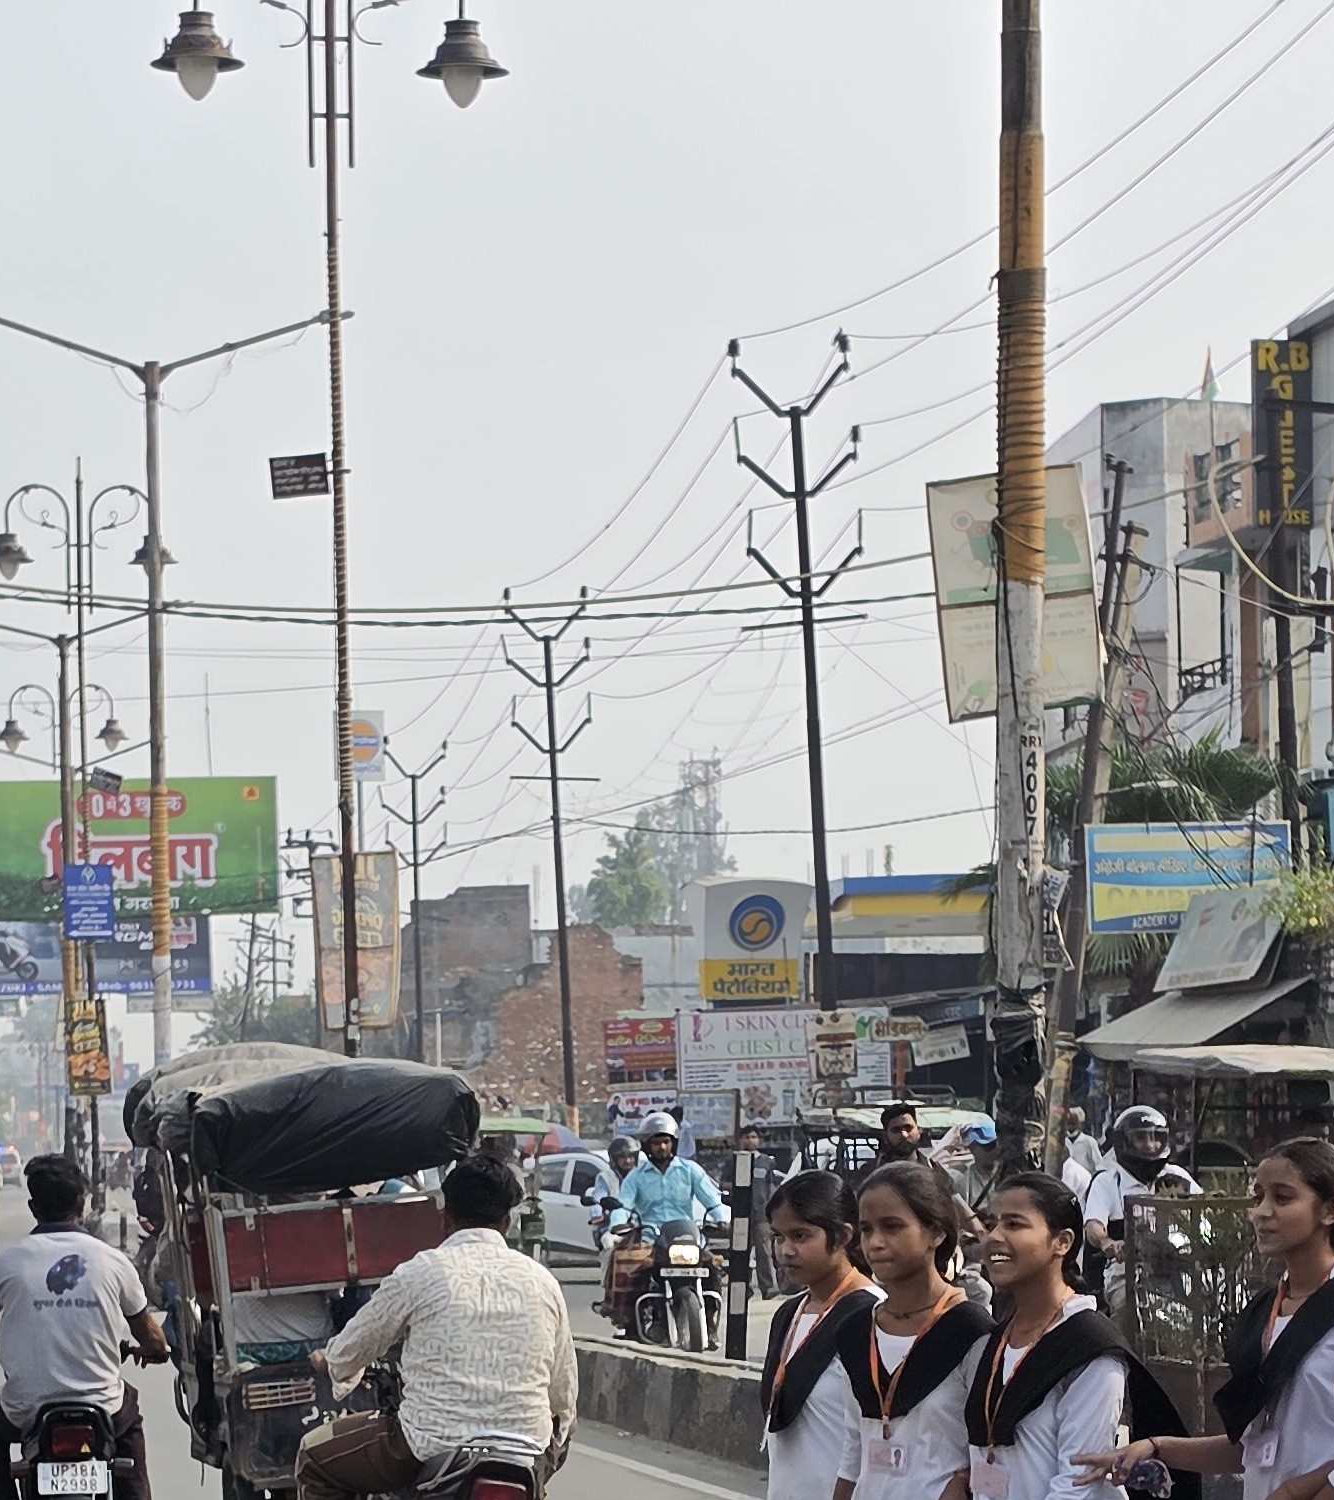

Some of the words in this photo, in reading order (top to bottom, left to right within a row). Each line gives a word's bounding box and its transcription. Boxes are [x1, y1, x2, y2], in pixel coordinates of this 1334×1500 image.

[1259, 509, 1310, 525] HUSE
[1026, 751, 1038, 836] 4007
[119, 793, 132, 818] 3
[1132, 913, 1168, 929] ACADEMY
[727, 962, 775, 977] भारत
[735, 1014, 778, 1031] SKIN
[726, 1038, 783, 1055] CHEST
[51, 1464, 98, 1478] UP38A
